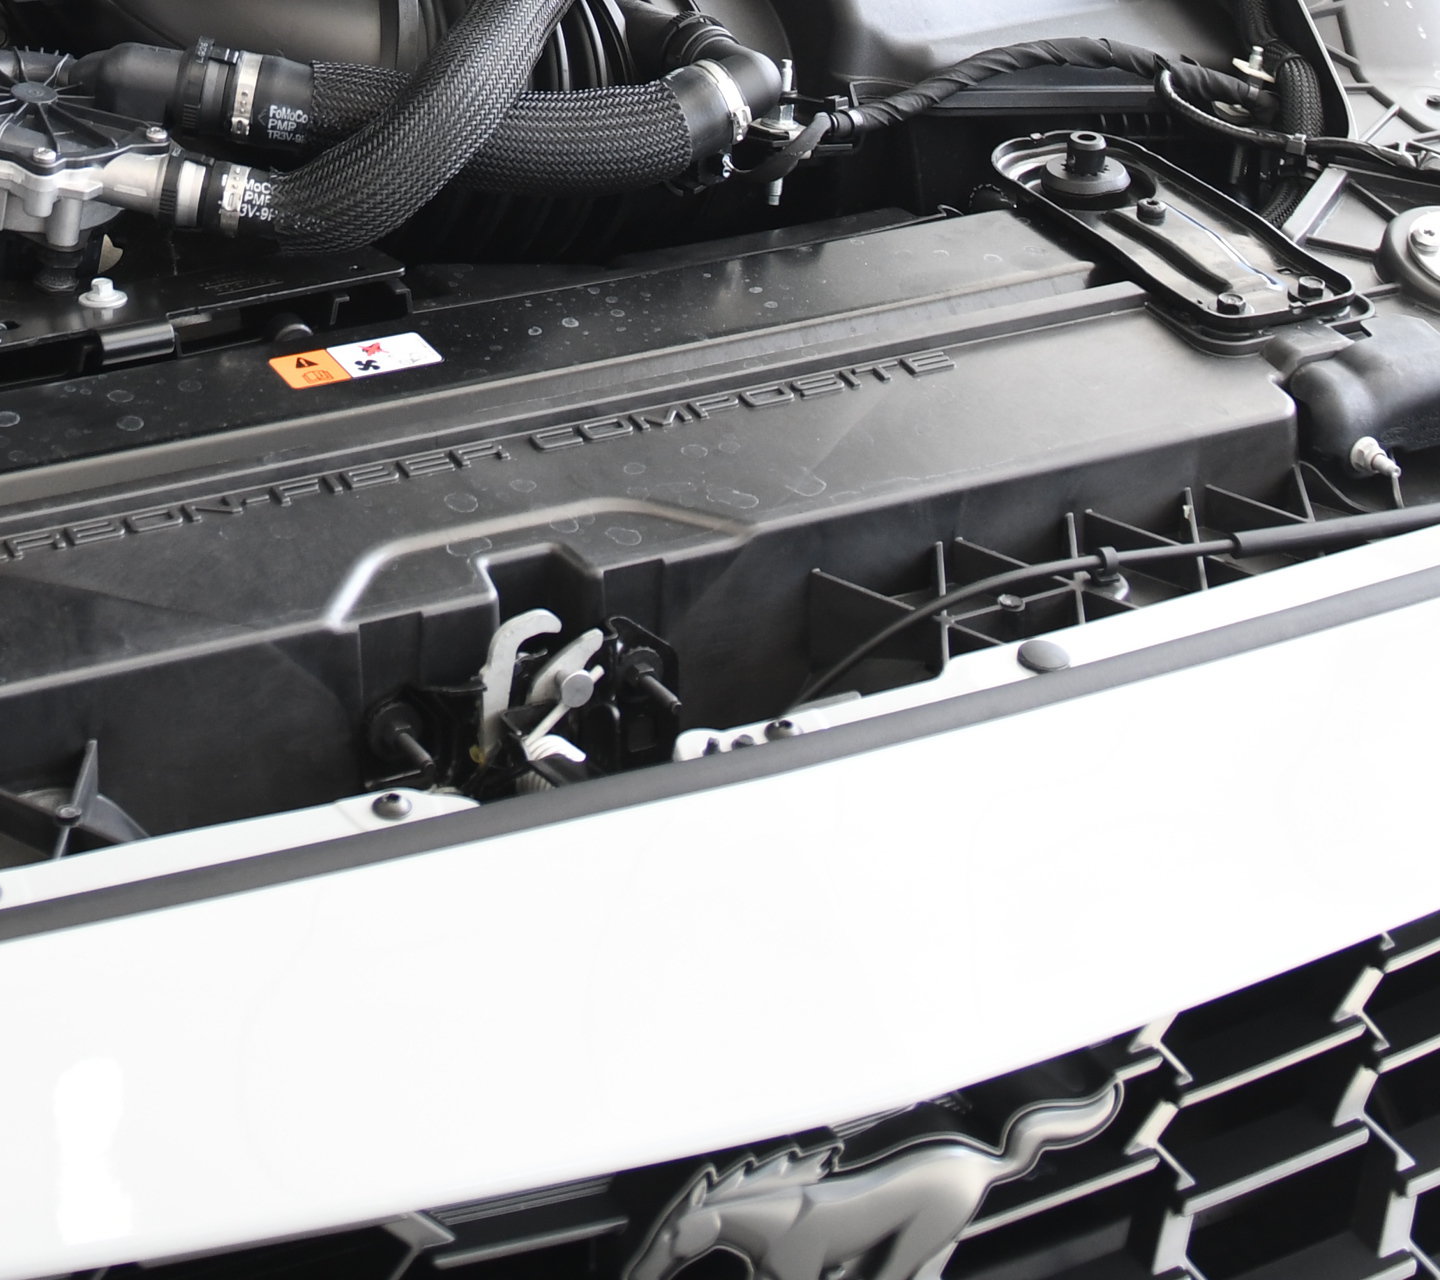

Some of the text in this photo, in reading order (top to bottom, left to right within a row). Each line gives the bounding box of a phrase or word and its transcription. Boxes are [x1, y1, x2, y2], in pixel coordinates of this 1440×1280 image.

[269, 105, 308, 123] FoMoCo
[268, 119, 297, 131] PMP
[531, 347, 957, 453] COMPOSITE
